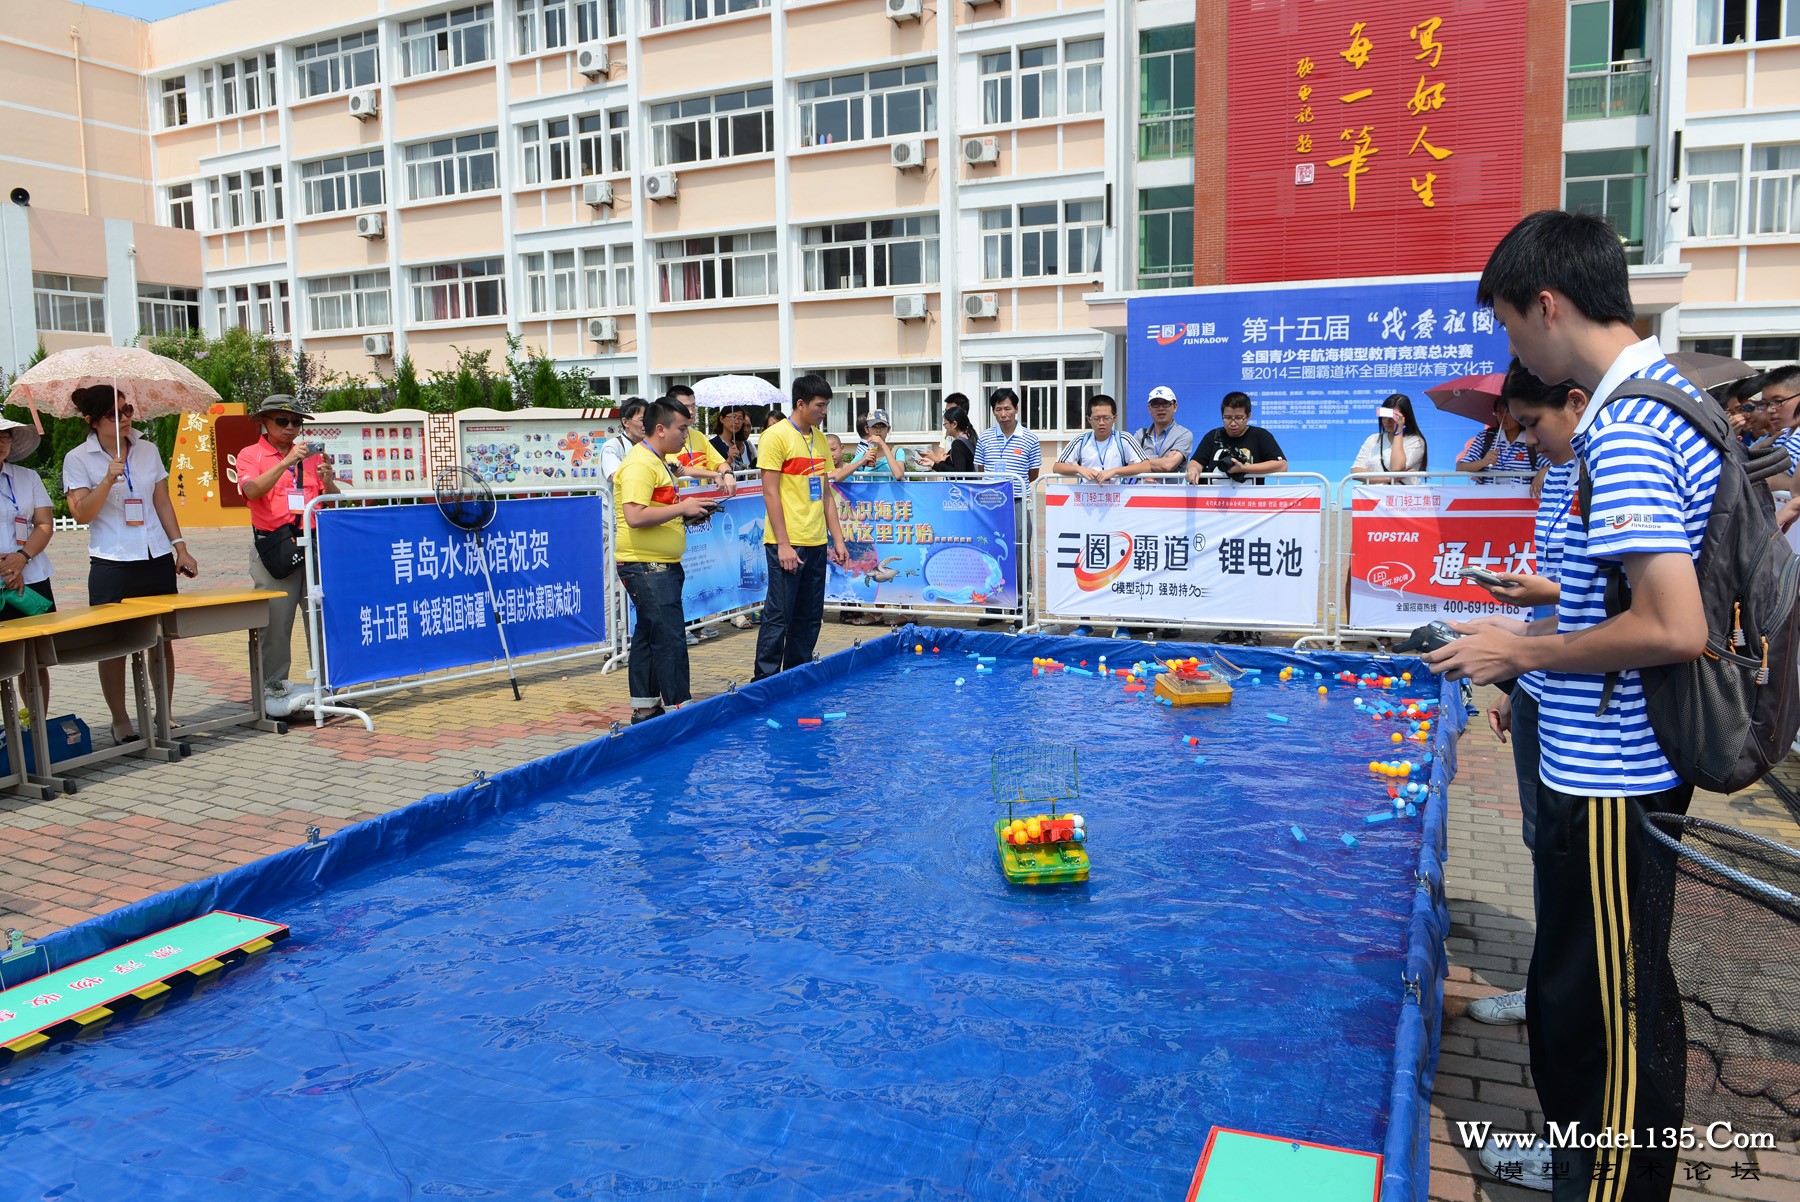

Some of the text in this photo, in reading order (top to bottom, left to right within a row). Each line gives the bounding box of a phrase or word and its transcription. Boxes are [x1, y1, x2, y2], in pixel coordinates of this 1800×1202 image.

[1407, 16, 1454, 208] 写好人生
[1183, 336, 1230, 345] SUNPADOW
[1241, 344, 1474, 364] 全国青少年航海模型教育竞赛总决赛
[1241, 360, 1495, 381] 暨2014三圈霸道杯全国模型体育文化节
[1074, 491, 1121, 502] 厦门轻工集团
[1385, 495, 1441, 507] 厦门轻工集团
[837, 500, 914, 522] 认识海洋
[1367, 531, 1419, 543] TOPSTAR
[390, 529, 550, 585] 青岛水族馆祝贺
[1218, 537, 1303, 577] 锂电池
[1373, 571, 1387, 583] LED
[1116, 581, 1198, 598] 模型动力 强劲持久
